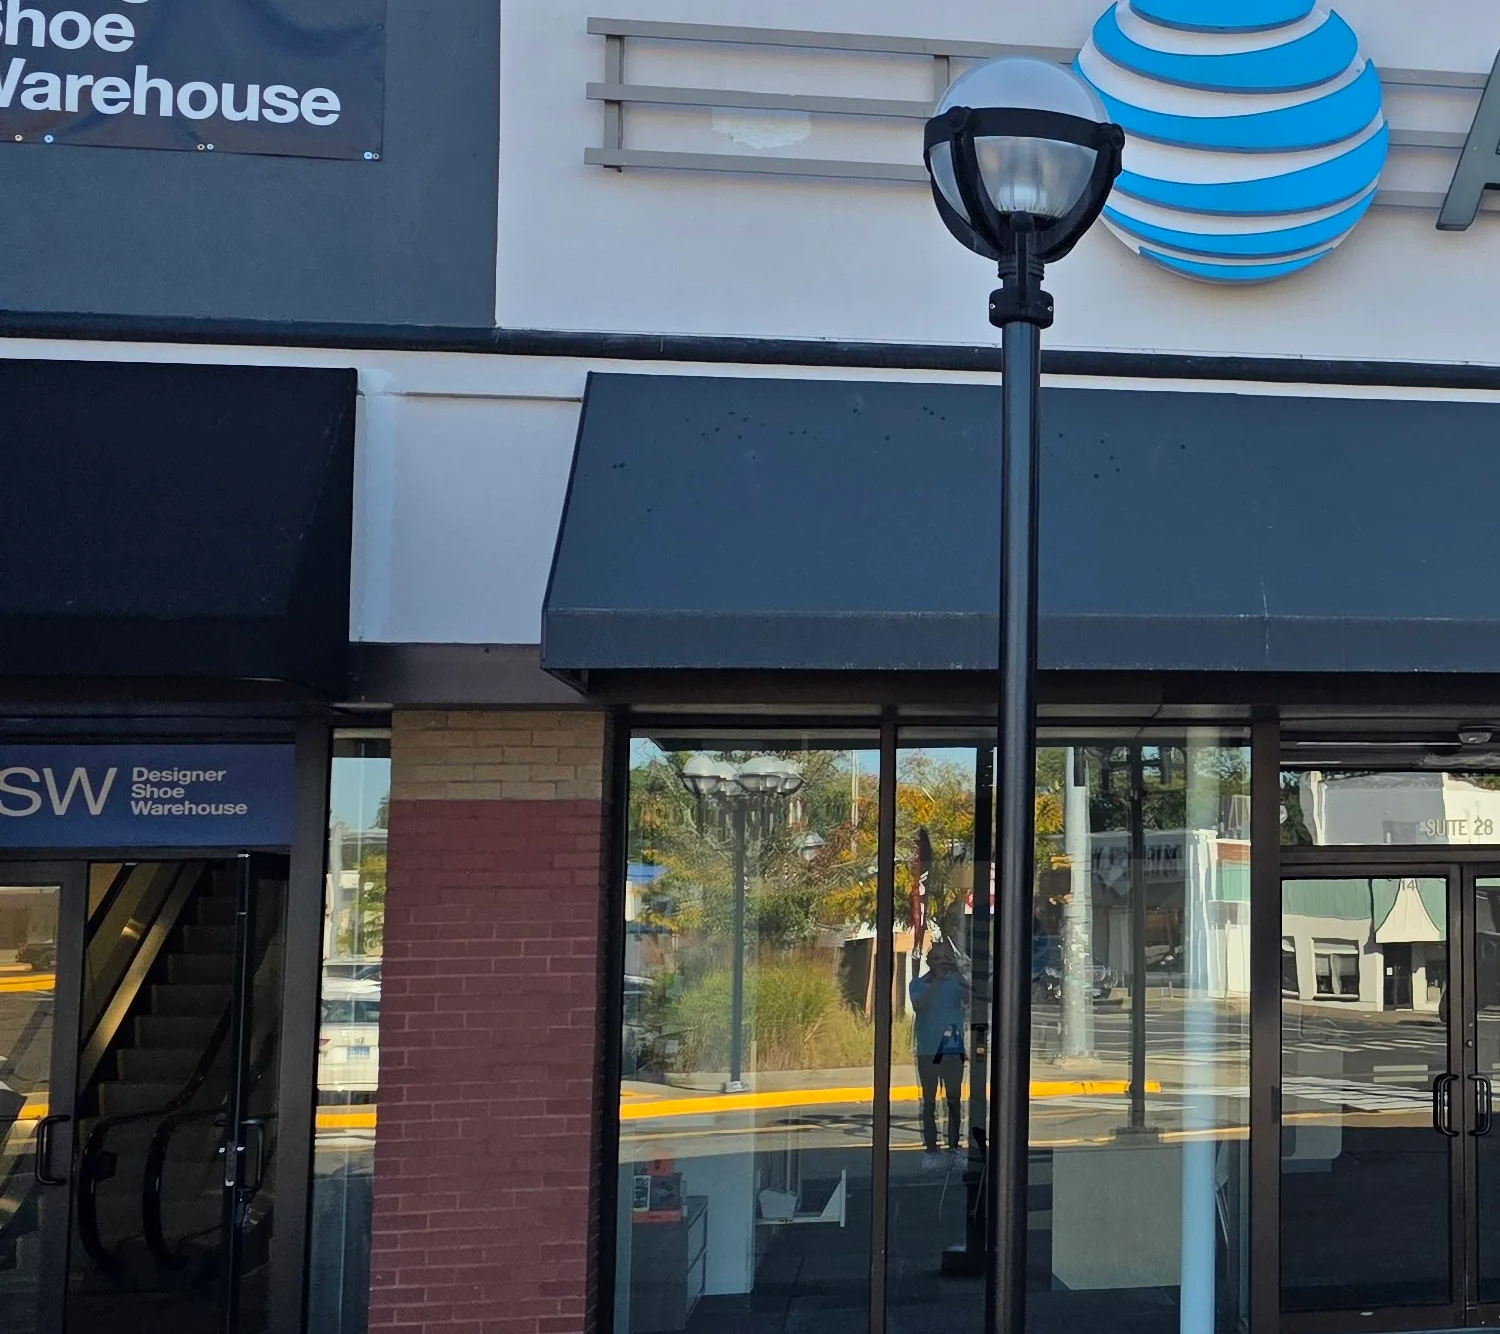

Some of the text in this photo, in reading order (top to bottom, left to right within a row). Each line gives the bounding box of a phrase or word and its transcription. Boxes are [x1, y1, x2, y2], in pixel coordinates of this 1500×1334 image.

[132, 766, 227, 785] Designer
[131, 784, 185, 799] Shoe
[131, 800, 248, 816] Warehouse
[1425, 818, 1494, 837] SUITE 28
